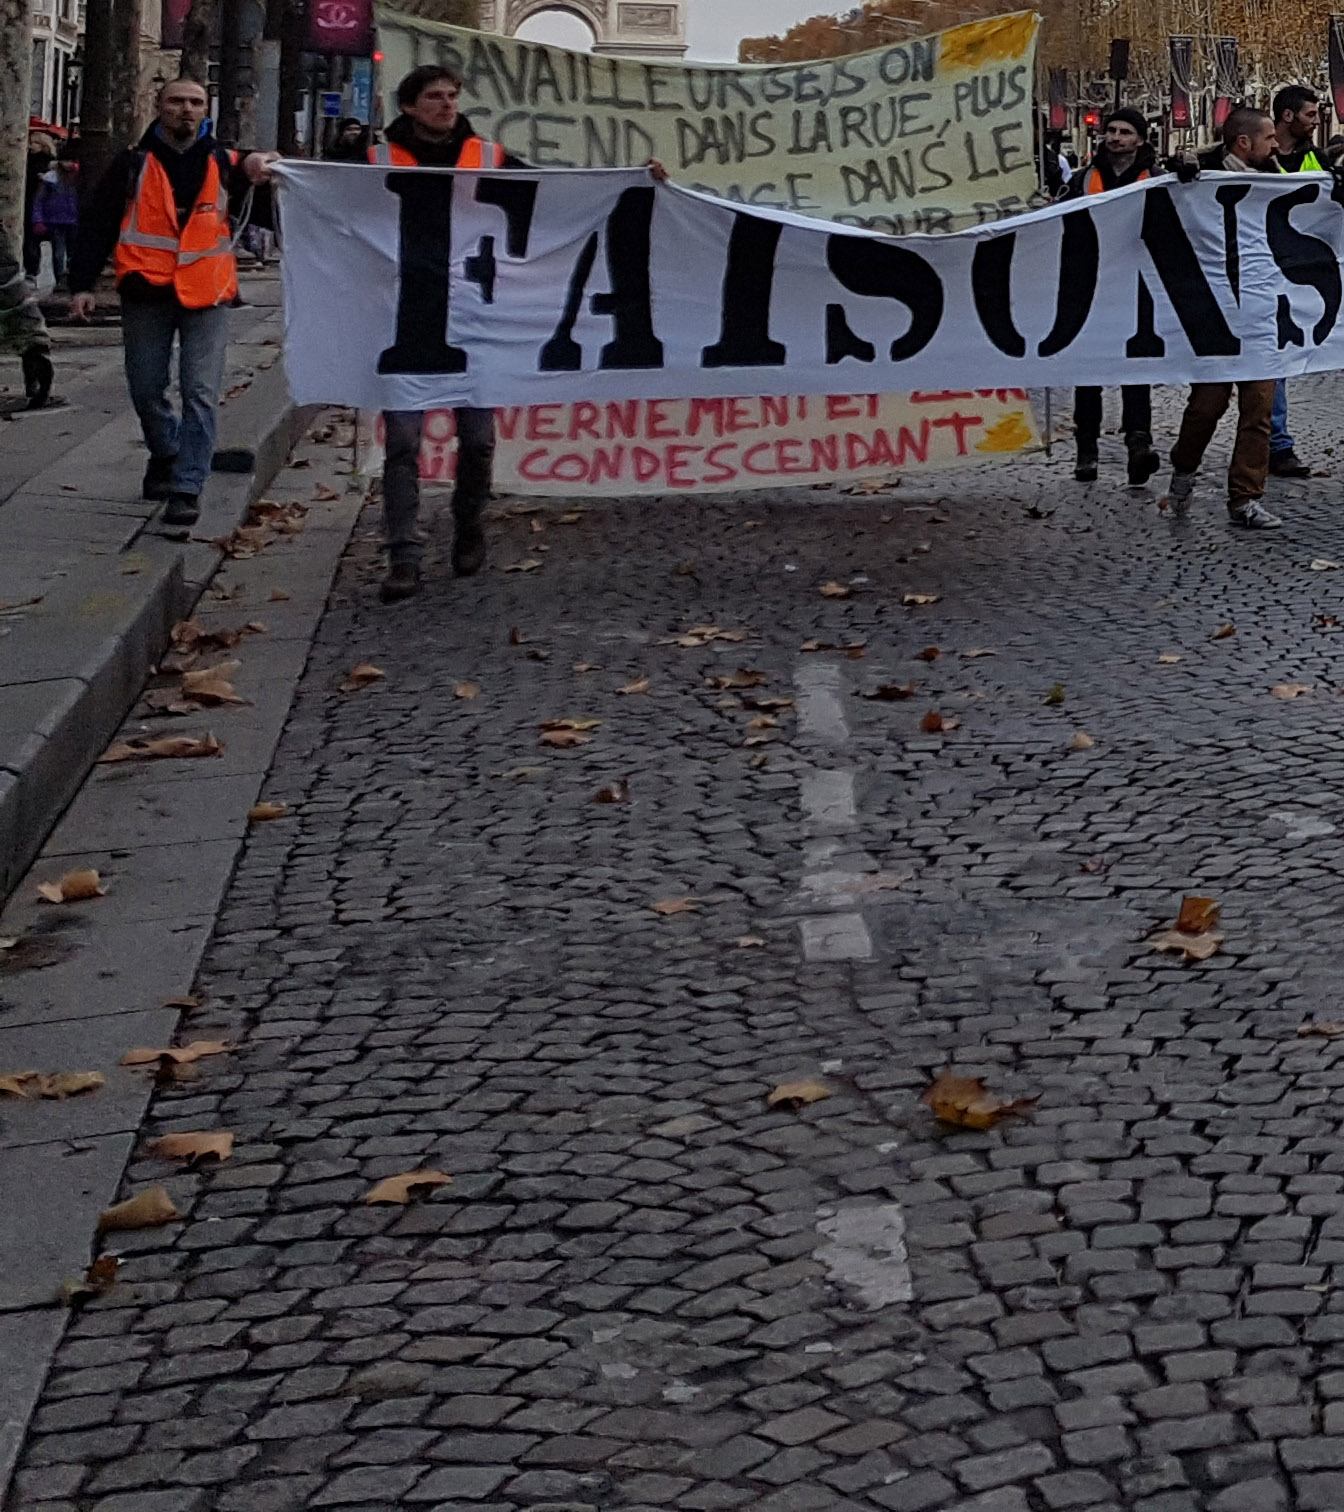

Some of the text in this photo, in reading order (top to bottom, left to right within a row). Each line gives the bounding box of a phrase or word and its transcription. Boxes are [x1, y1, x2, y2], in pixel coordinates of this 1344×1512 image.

[879, 39, 936, 86] ON
[676, 109, 776, 170] DANS
[955, 65, 1027, 123] PLUS
[840, 140, 952, 207] DANS
[965, 120, 1031, 181] LE
[517, 411, 984, 489] CONDESCENDANT
